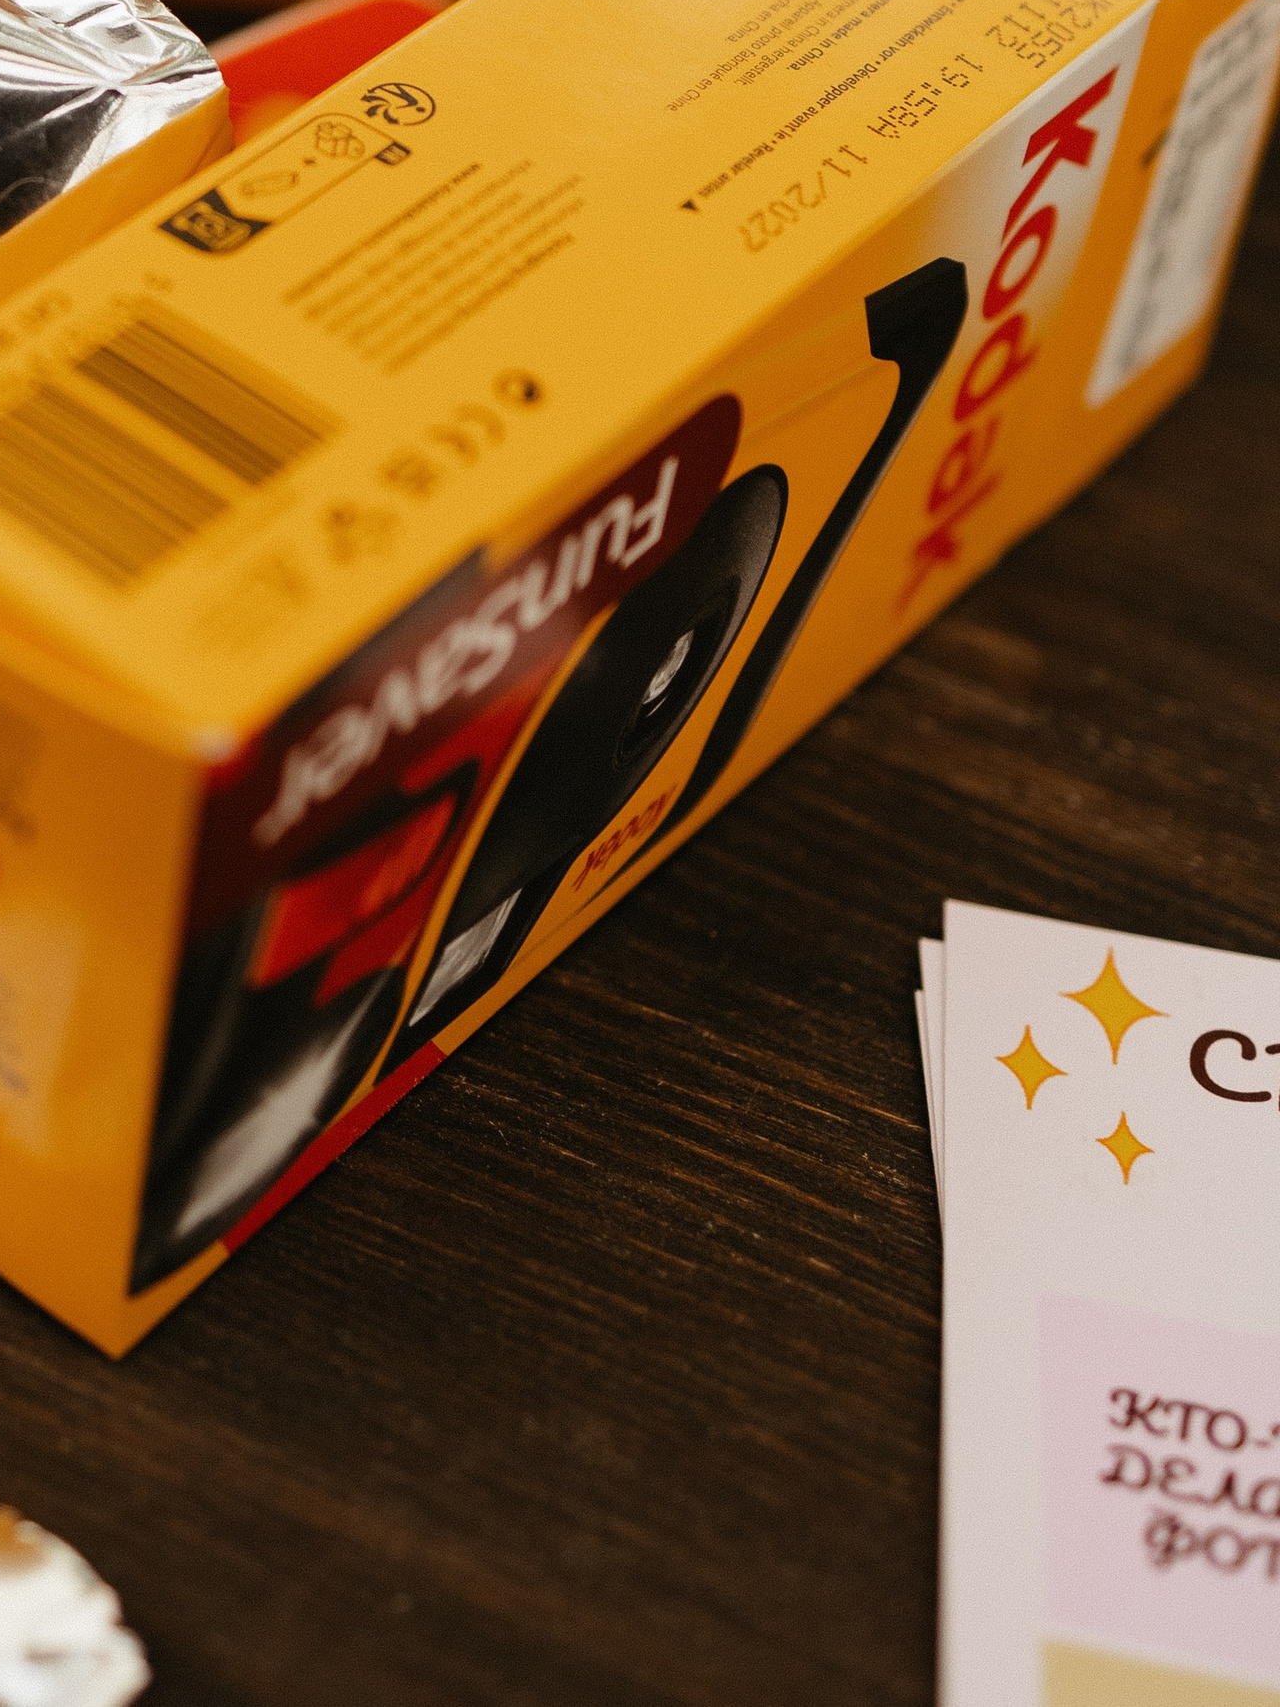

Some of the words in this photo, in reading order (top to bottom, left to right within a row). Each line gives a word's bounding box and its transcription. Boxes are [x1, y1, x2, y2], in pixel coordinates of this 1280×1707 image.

[749, 23, 783, 53] photo
[787, 21, 819, 51] China
[819, 35, 835, 51] in
[831, 14, 864, 43] made
[894, 3, 952, 51] Entwickeln
[708, 43, 755, 84] fabriqué
[732, 41, 791, 91] hergestellt.
[785, 43, 824, 78] China.
[878, 42, 899, 62] vor
[695, 76, 712, 92] en
[813, 57, 878, 112] Développer
[773, 126, 791, 144] le
[783, 104, 819, 135] avant
[738, 145, 867, 253] 11/2027
[895, 64, 1120, 620] Kodak
[252, 456, 679, 850] FunSaver
[1190, 1029, 1280, 1111] С
[1109, 1387, 1280, 1453] КТО-
